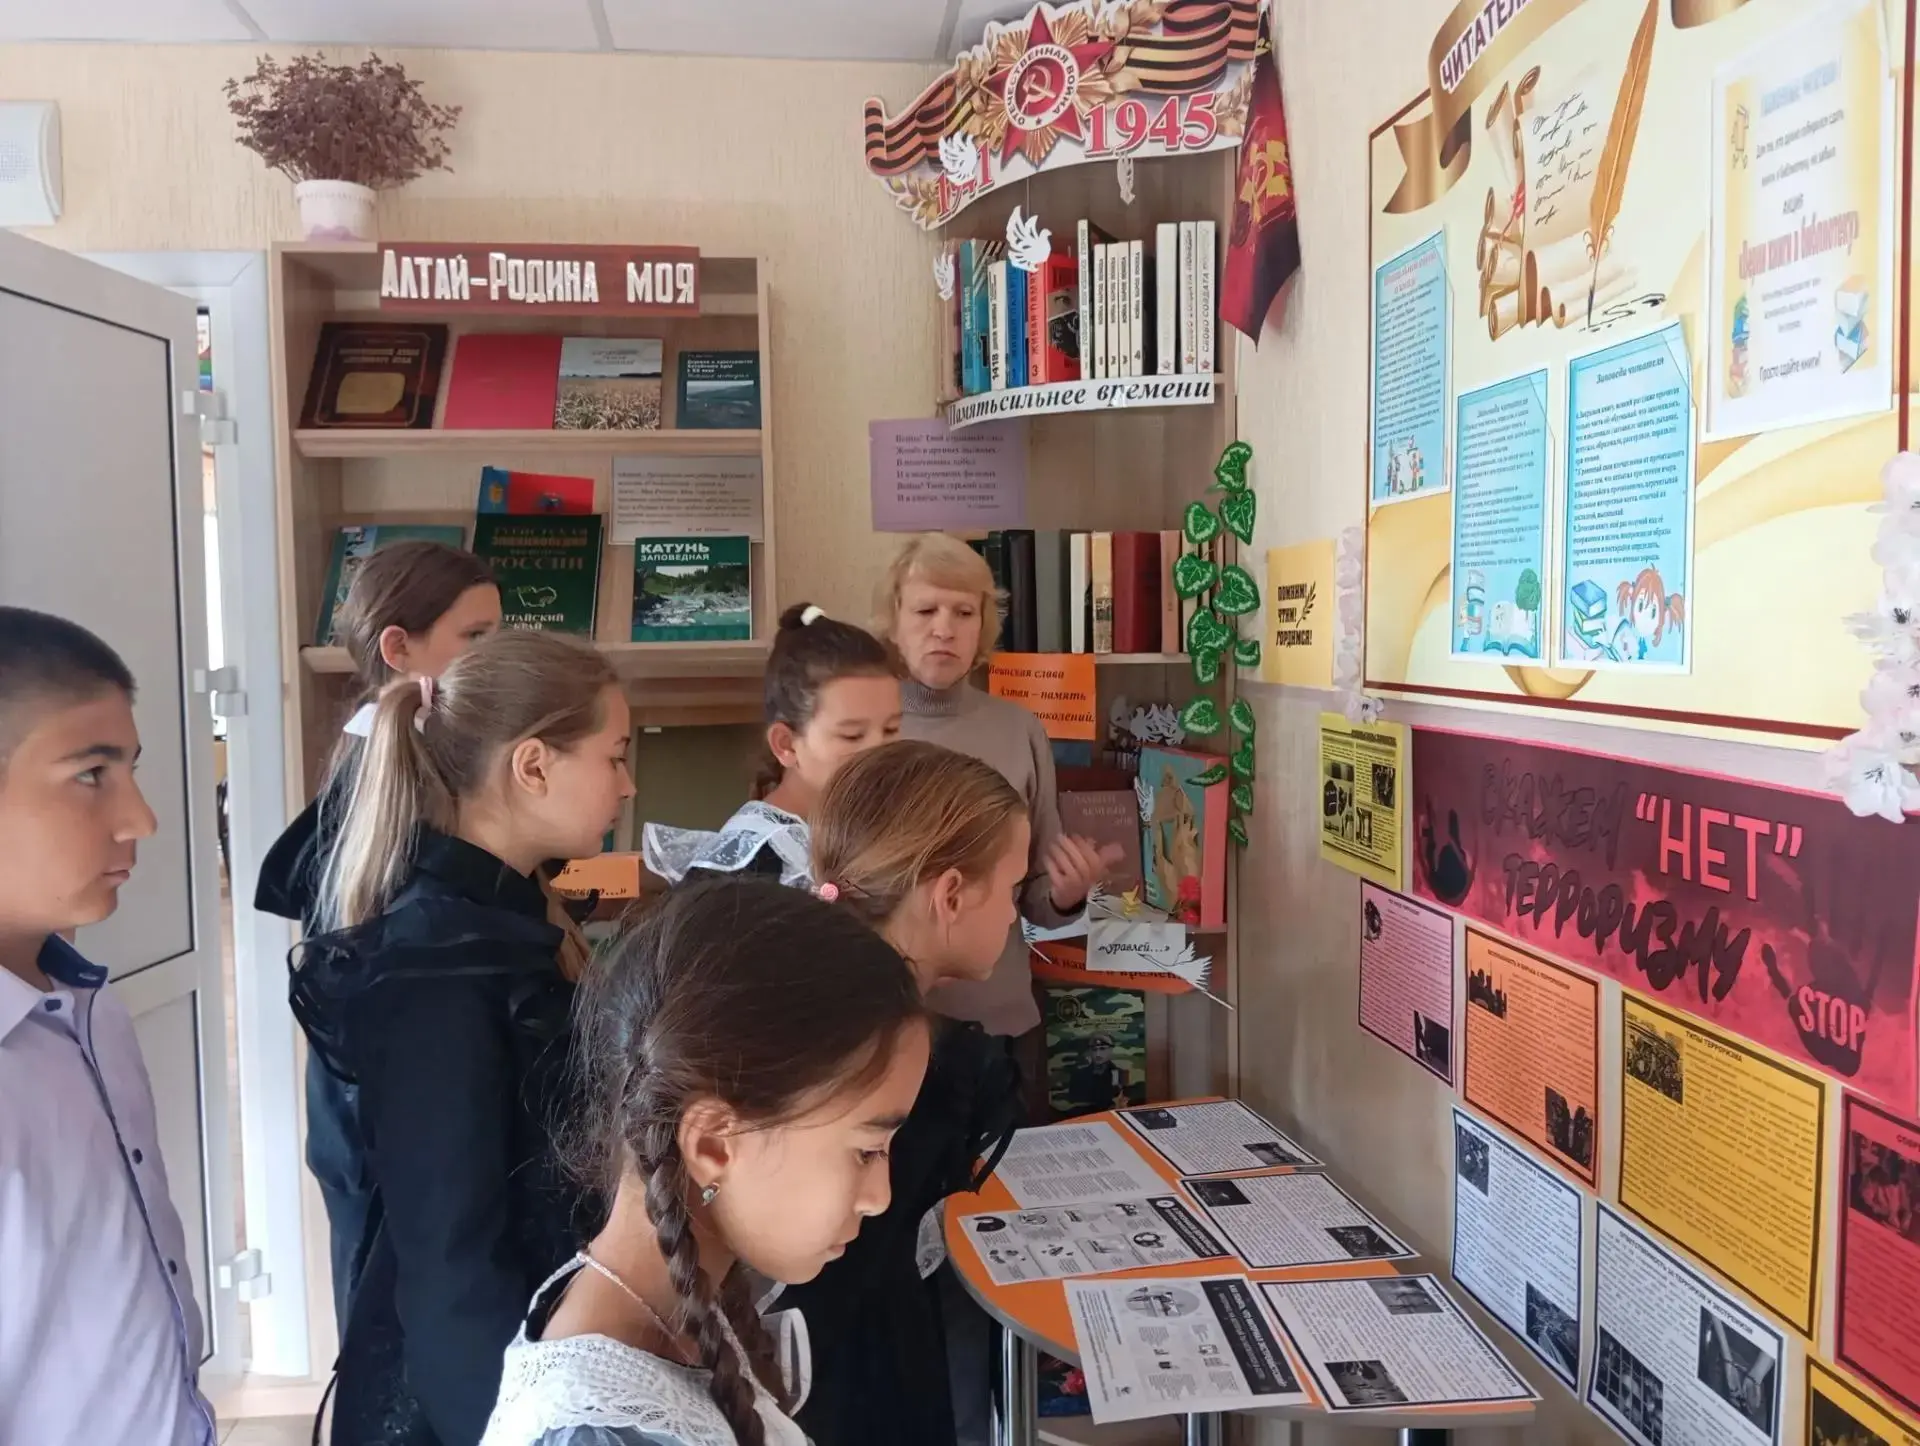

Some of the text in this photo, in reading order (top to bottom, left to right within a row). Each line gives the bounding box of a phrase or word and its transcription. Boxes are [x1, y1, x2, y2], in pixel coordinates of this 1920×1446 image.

[1053, 65, 1076, 114] ВОЙНА
[1084, 91, 1217, 156] 1945
[1030, 315, 1040, 356] ЖИВАЯ
[992, 352, 1000, 381] 1418
[1000, 388, 1086, 411] сильнее
[1097, 380, 1211, 408] времени
[641, 542, 710, 554] КАТУНЬ
[641, 553, 710, 562] ЗАПОВЕДНАЯ
[1276, 629, 1313, 649] ГОРДИМСЯ!
[1035, 670, 1065, 679] слава
[1041, 691, 1087, 701] память
[1503, 853, 1751, 1004] ТЕРРОРИЗМУ
[1798, 984, 1866, 1052] STOP
[1704, 1039, 1743, 1063] ТЕРРОРИЗМА
